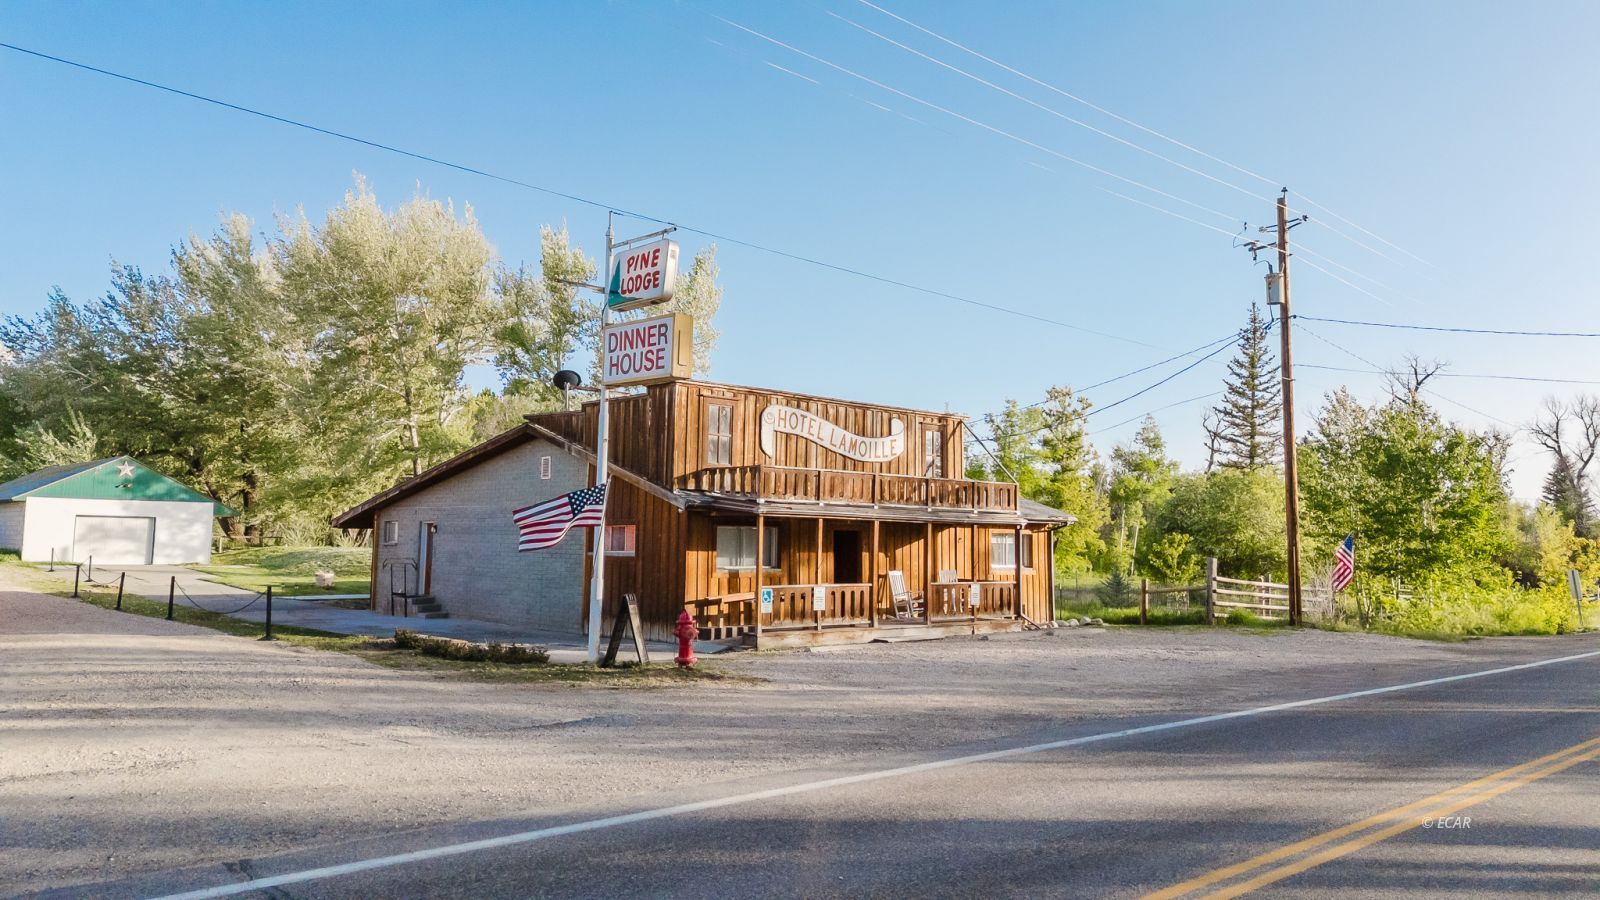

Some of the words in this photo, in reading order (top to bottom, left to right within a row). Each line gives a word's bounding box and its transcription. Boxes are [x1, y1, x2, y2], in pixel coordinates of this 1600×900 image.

[626, 248, 660, 274] PINE
[620, 270, 660, 296] LODGE
[608, 323, 668, 353] DINNER
[609, 347, 666, 376] HOUSE
[777, 409, 824, 441] HOTEL
[830, 428, 897, 459] LAMOILLE
